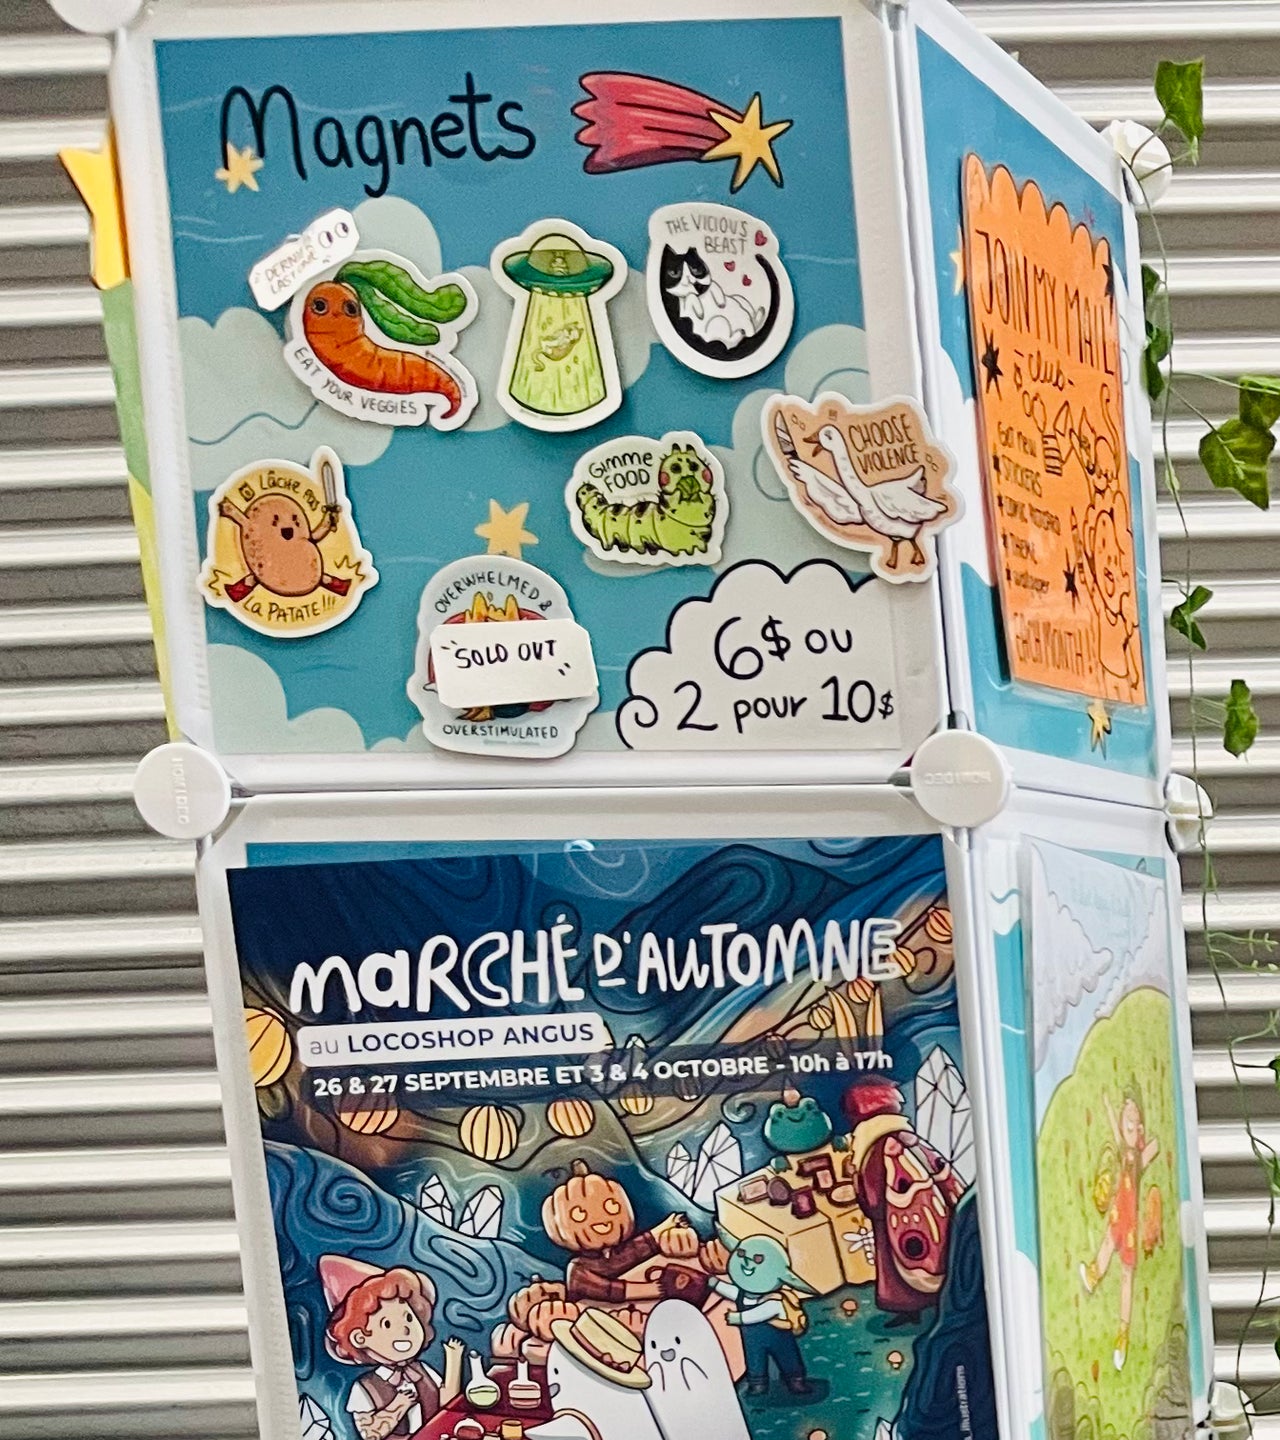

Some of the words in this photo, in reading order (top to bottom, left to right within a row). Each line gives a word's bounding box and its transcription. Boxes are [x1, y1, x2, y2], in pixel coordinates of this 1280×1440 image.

[219, 73, 536, 197] Magnets
[665, 218, 690, 235] THE
[692, 213, 749, 237] VICIOUS
[703, 236, 747, 256] BEAST
[976, 230, 1030, 332] JOIN
[1033, 260, 1057, 347] MY
[1064, 281, 1114, 376] MAIL
[848, 412, 914, 450] CHOOSE
[588, 450, 654, 479] Gimme
[857, 442, 920, 474] VIOLENCE
[604, 467, 651, 491] FOOD
[435, 571, 540, 614] OVERWHELMED
[714, 615, 798, 680] 6$
[808, 628, 853, 656] ou
[674, 680, 718, 733] 2
[734, 691, 807, 733] pour
[821, 676, 895, 721] 10$
[443, 724, 558, 740] OVERSTIMULATED
[309, 1036, 341, 1056] au
[346, 1027, 495, 1055] LOCOSHOP
[502, 1023, 595, 1047] ANGUS
[313, 1076, 343, 1097] 26
[349, 1076, 366, 1095] &
[371, 1073, 399, 1095] 27
[404, 1066, 550, 1092] SEPTEMBRE
[555, 1064, 584, 1084] ET
[590, 1064, 604, 1083] 3
[609, 1063, 627, 1082] &
[631, 1061, 649, 1081] 4
[654, 1055, 769, 1080] OCTOBRE
[789, 1053, 829, 1073] 10h
[834, 1051, 850, 1072] à
[855, 1050, 893, 1070] 17h
